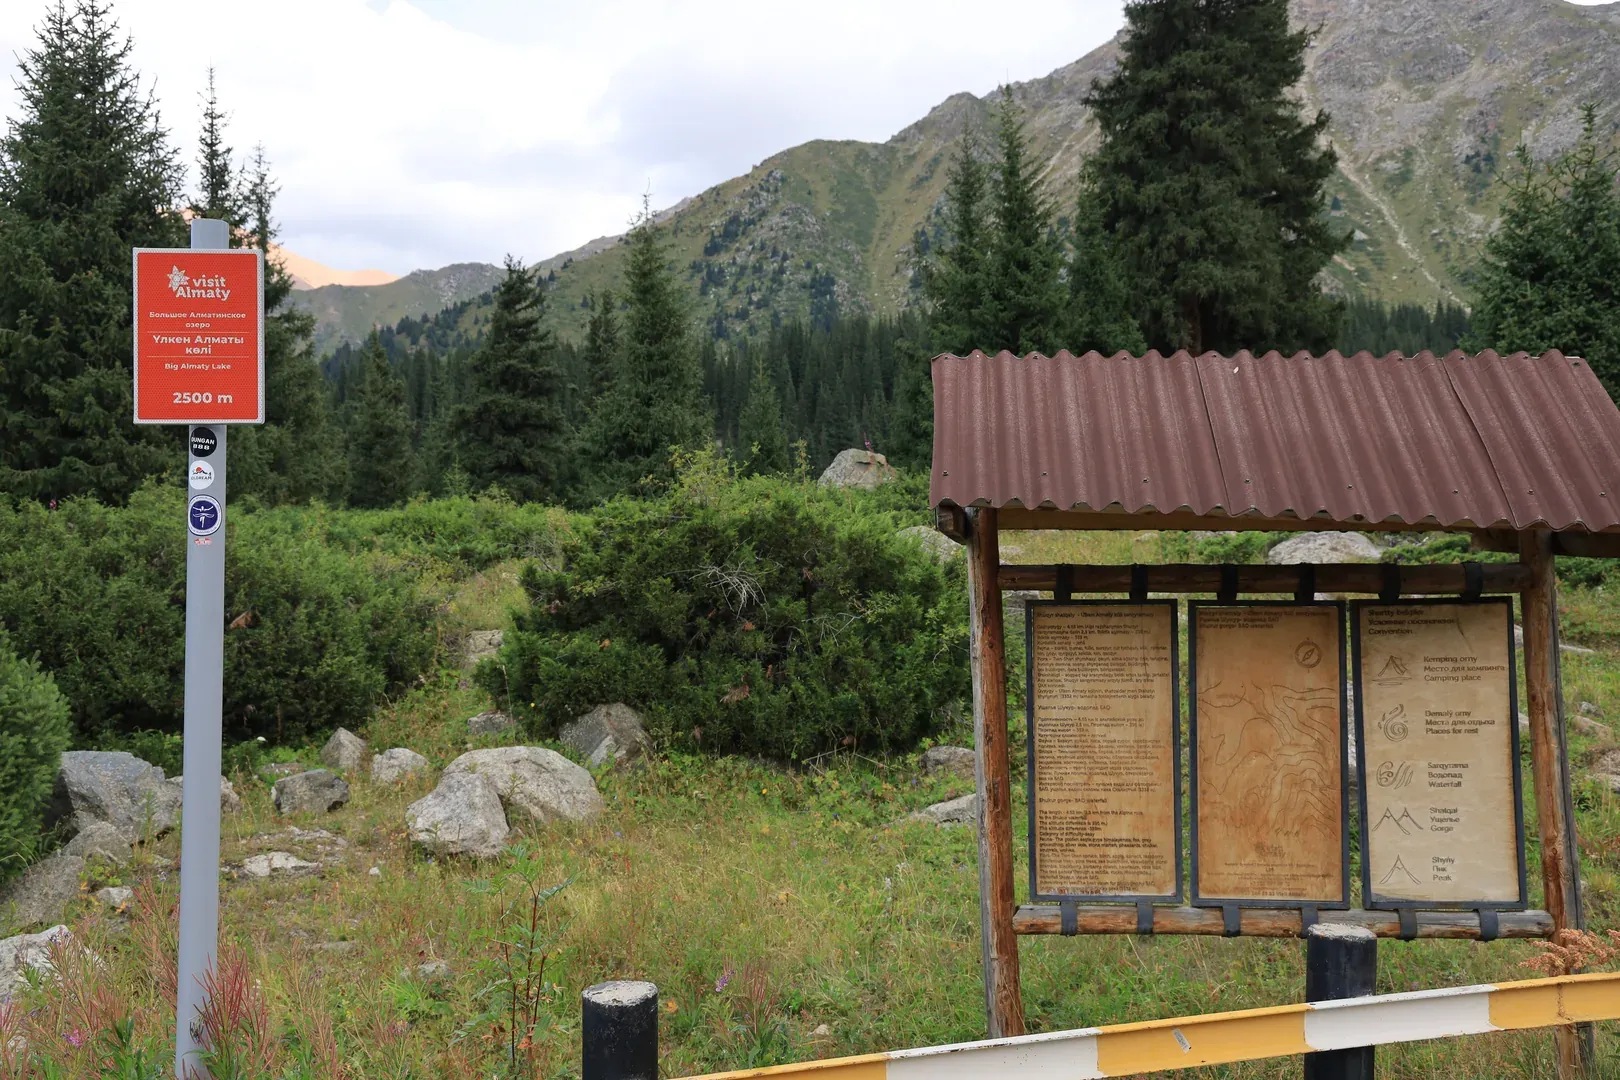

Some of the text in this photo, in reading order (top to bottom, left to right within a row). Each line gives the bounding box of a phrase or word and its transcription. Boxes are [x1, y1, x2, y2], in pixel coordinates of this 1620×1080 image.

[192, 275, 226, 288] visit
[176, 286, 230, 301] Almaty
[186, 322, 210, 330] озеро
[194, 335, 244, 344] Алматы
[172, 392, 233, 404] 2500 m
